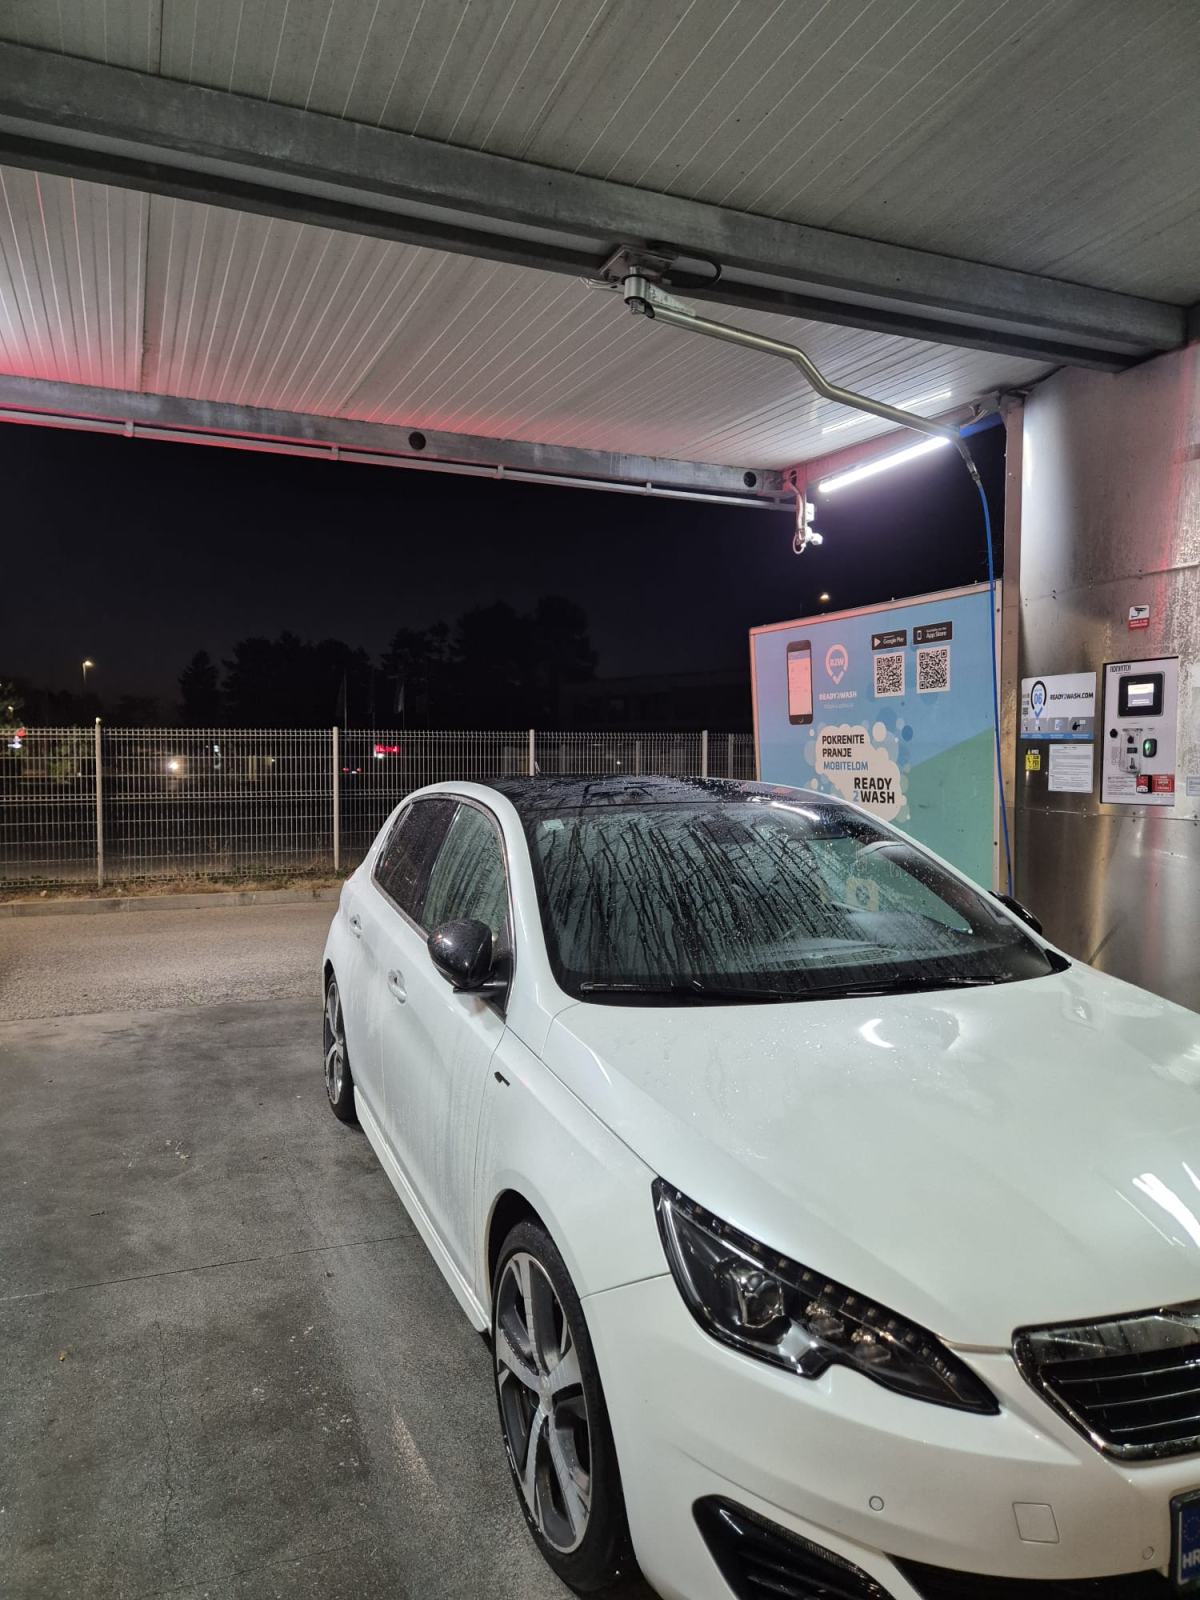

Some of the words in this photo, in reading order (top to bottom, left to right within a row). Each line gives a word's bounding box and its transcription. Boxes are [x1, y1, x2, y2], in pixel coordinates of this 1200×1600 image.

[822, 734, 864, 744] POKRENITE
[822, 748, 852, 758] PRANJE
[824, 761, 868, 770] MOBITELOM
[854, 777, 892, 790] READY
[1182, 1548, 1200, 1569] HR
